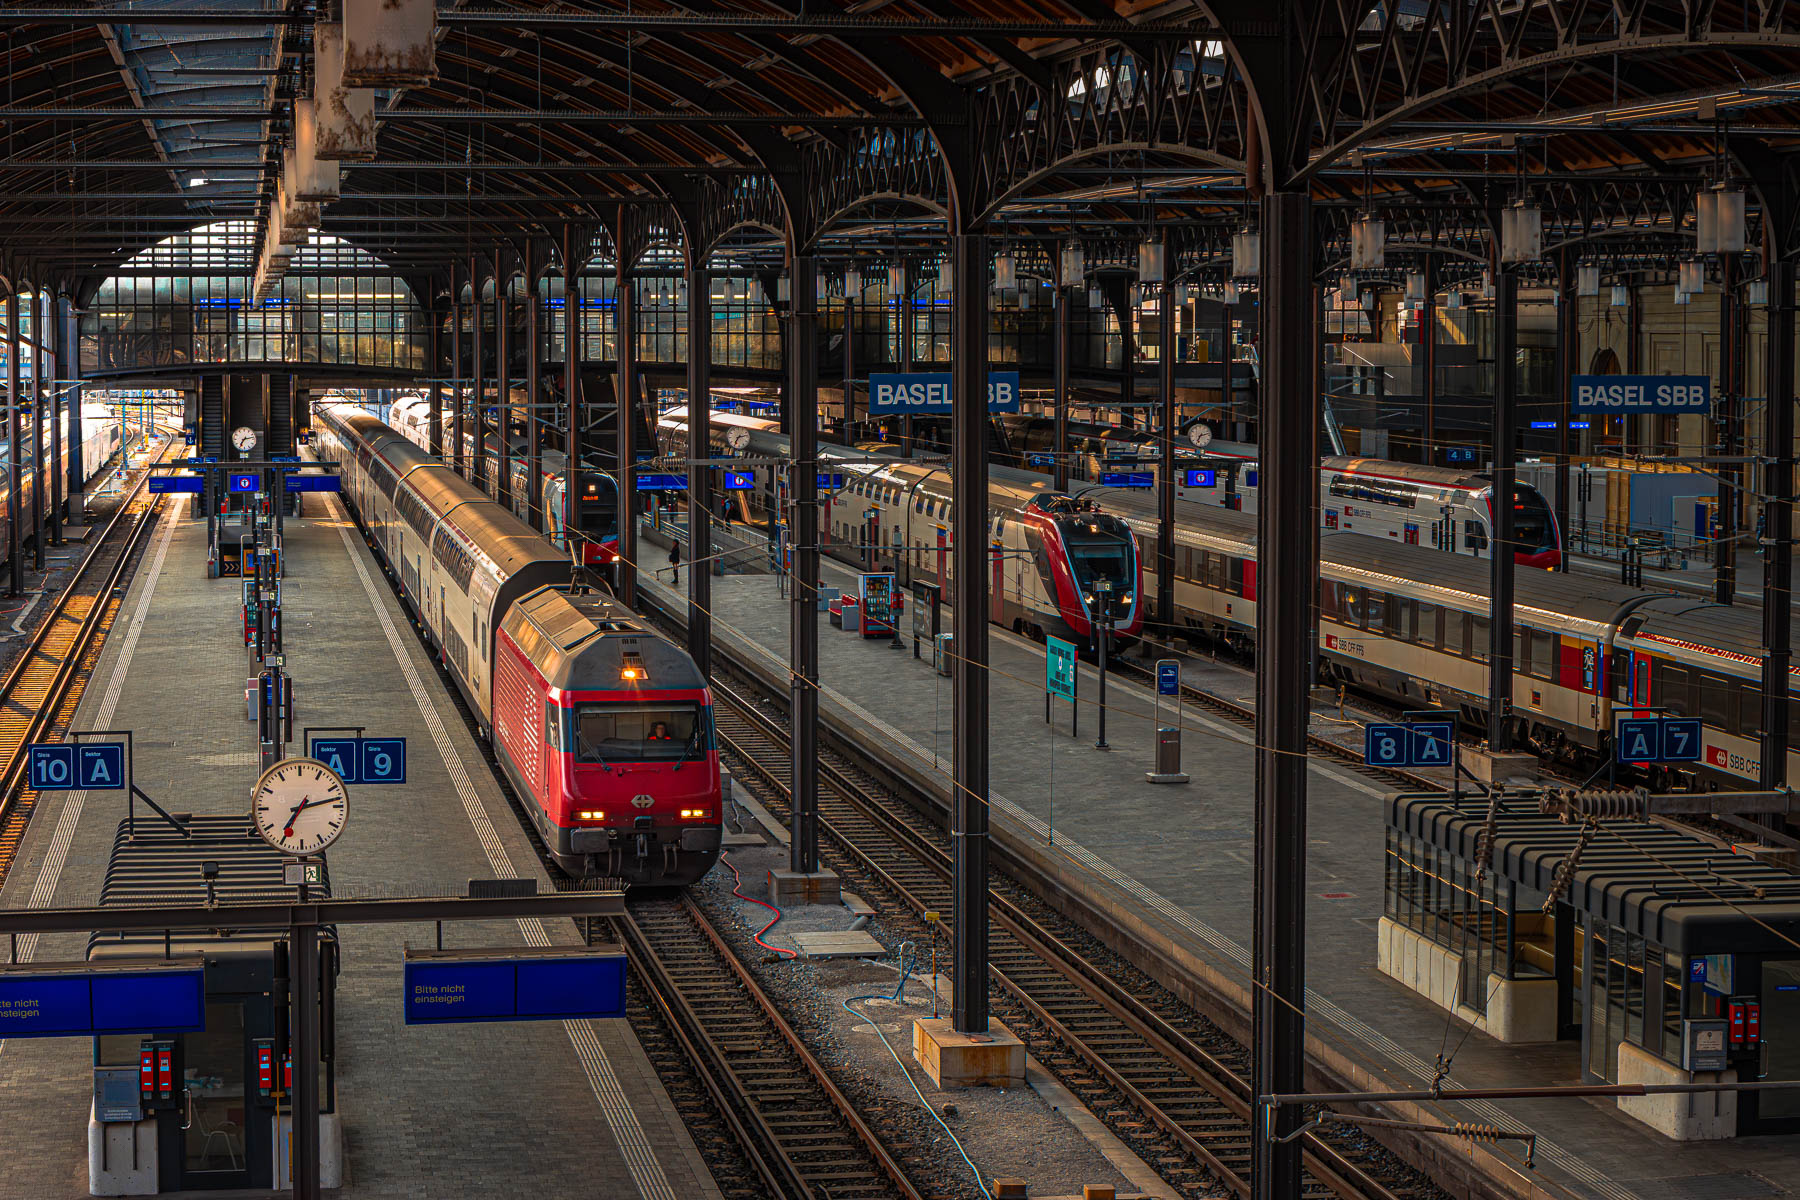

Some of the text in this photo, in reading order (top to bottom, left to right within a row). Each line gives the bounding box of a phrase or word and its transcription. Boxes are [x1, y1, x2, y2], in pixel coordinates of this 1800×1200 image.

[877, 383, 952, 405] BASEL
[1578, 385, 1705, 406] BASEL SBB
[1450, 450, 1458, 459] 4
[1338, 639, 1347, 652] SBB
[1379, 737, 1397, 760] 8
[1421, 737, 1441, 759] A
[1630, 733, 1649, 755] A
[1673, 732, 1689, 754] 7
[37, 759, 68, 783] 10
[90, 758, 110, 782] A
[328, 753, 346, 777] A
[373, 752, 392, 776] 9
[1729, 753, 1761, 776] SBB CFF
[414, 994, 465, 1005] einsteigen
[415, 984, 465, 994] Bitte nicht
[14, 999, 39, 1008] nicht
